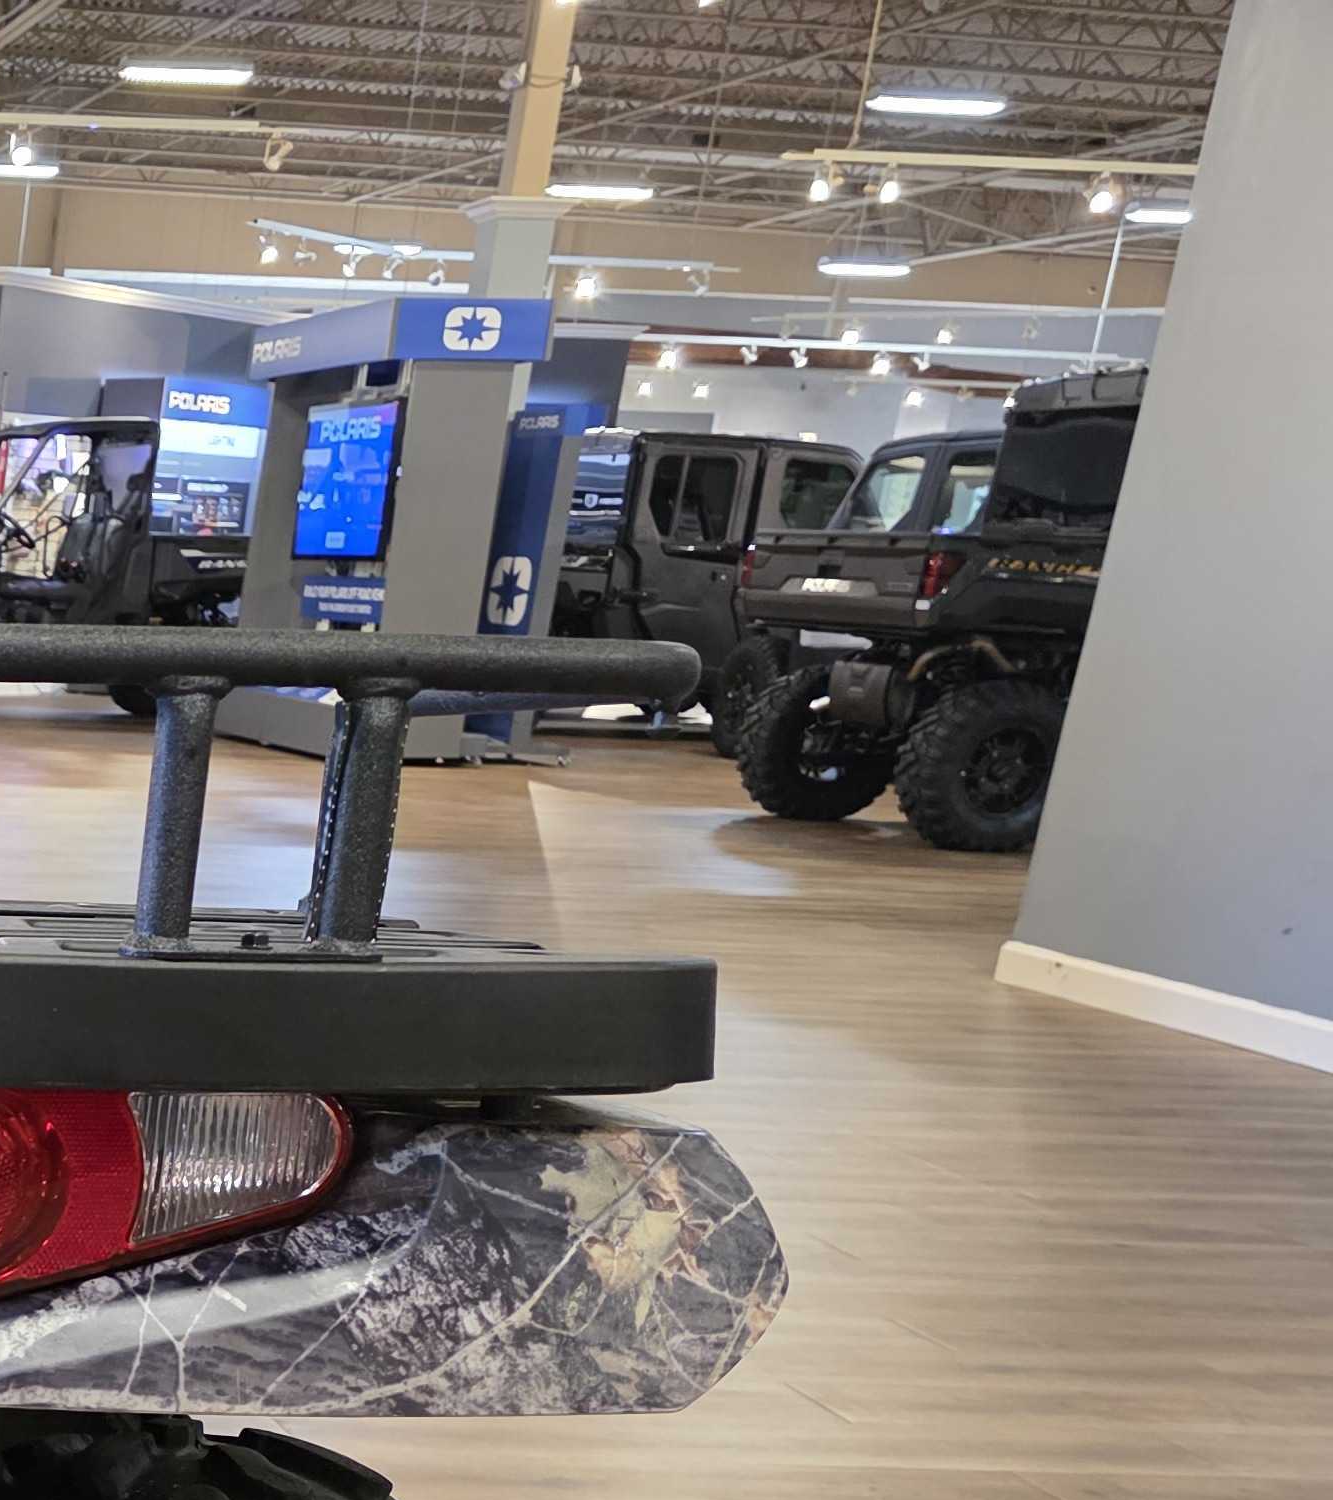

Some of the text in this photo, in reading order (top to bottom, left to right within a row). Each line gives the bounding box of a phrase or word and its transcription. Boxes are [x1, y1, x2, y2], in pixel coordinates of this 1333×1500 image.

[252, 337, 301, 363] POLARIS
[169, 391, 230, 414] POLARIS
[321, 416, 381, 441] POLARIS
[519, 415, 559, 430] POLARIS
